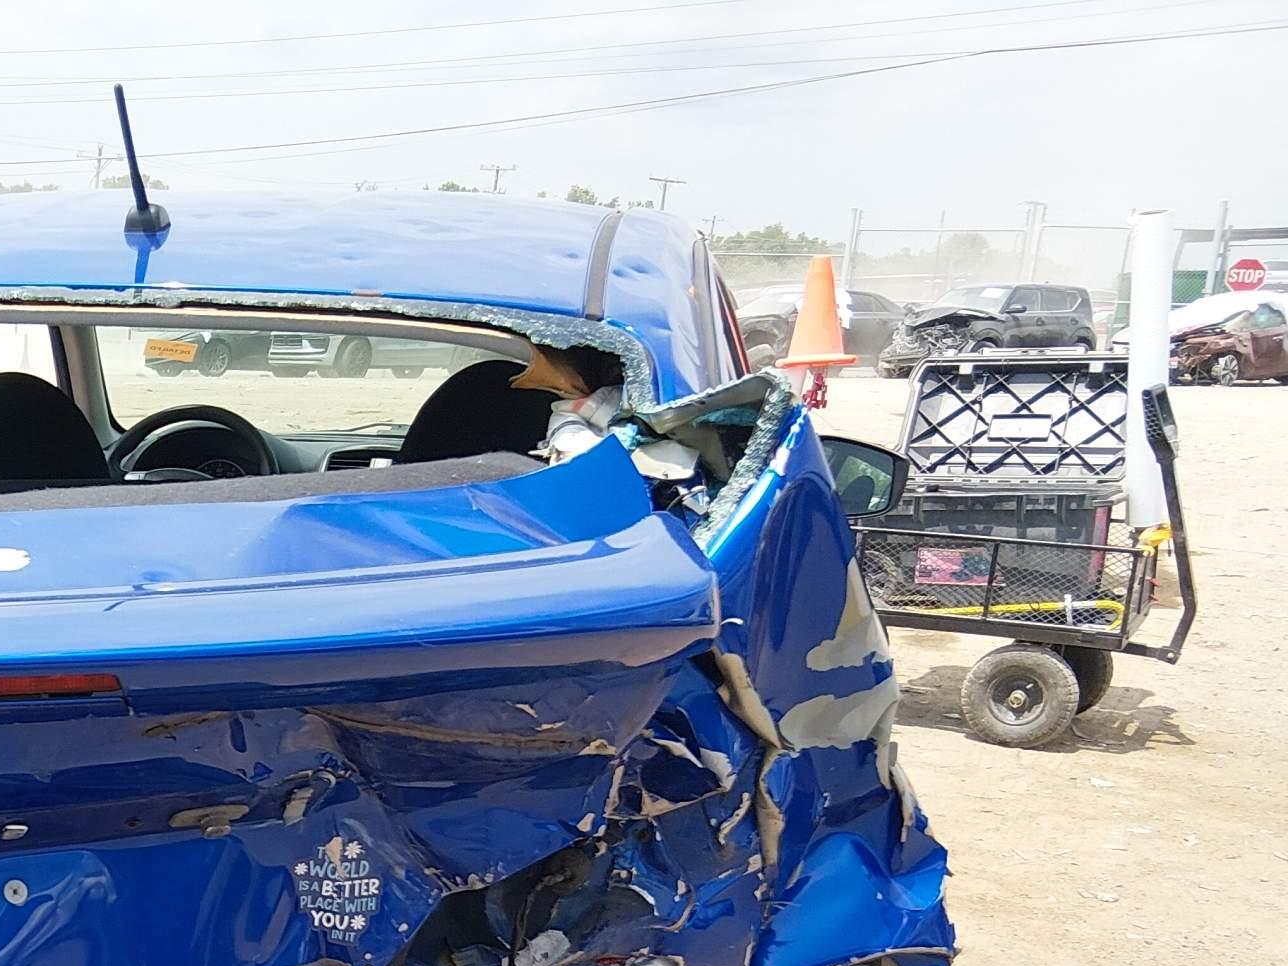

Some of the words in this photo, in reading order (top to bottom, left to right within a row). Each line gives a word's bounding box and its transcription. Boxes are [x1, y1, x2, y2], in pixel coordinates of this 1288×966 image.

[1228, 269, 1265, 283] STOP
[309, 860, 369, 880] WORLD
[299, 880, 310, 891] IS
[311, 881, 319, 892] A
[300, 896, 342, 912] PLACE
[344, 897, 377, 913] WITH
[311, 910, 349, 930] YOU
[331, 930, 343, 940] IN
[345, 931, 357, 942] IT
